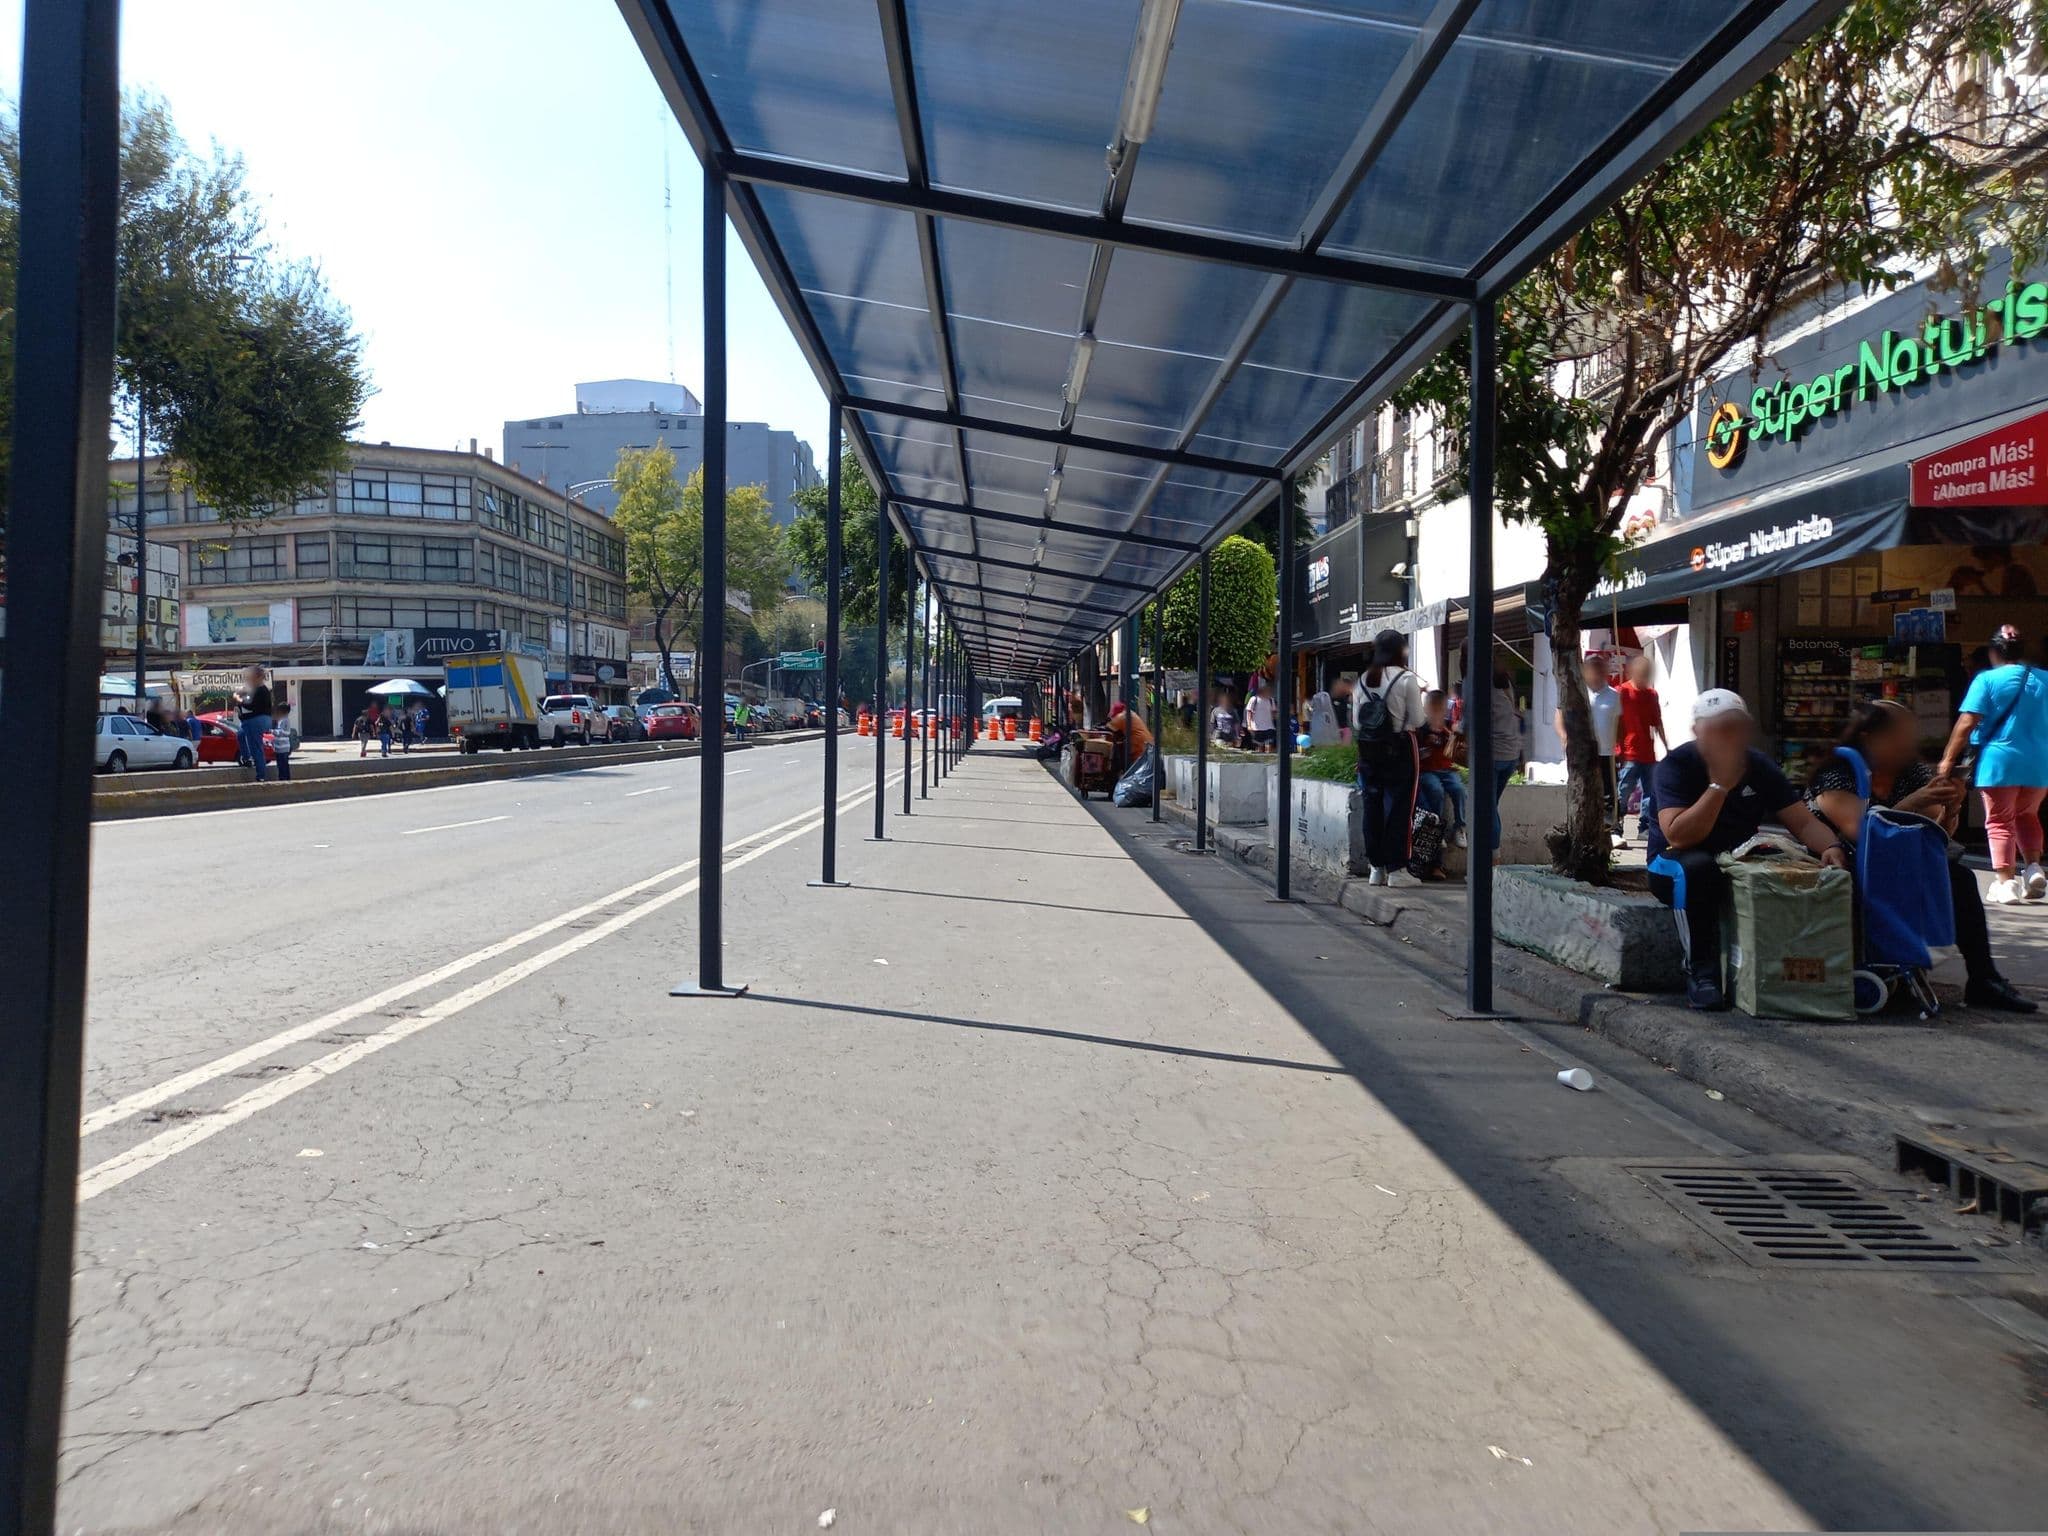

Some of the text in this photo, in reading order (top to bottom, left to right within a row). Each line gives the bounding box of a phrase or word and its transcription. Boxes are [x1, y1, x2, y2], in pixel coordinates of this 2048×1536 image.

[1748, 364, 1853, 442] Súper
[1928, 438, 2034, 480] ¡Compra Más!
[1933, 466, 2035, 501] ¡Ahorra Más!
[1750, 514, 1833, 557] Naturista
[417, 637, 475, 652] ATTIVO
[1789, 639, 1840, 649] Botanas
